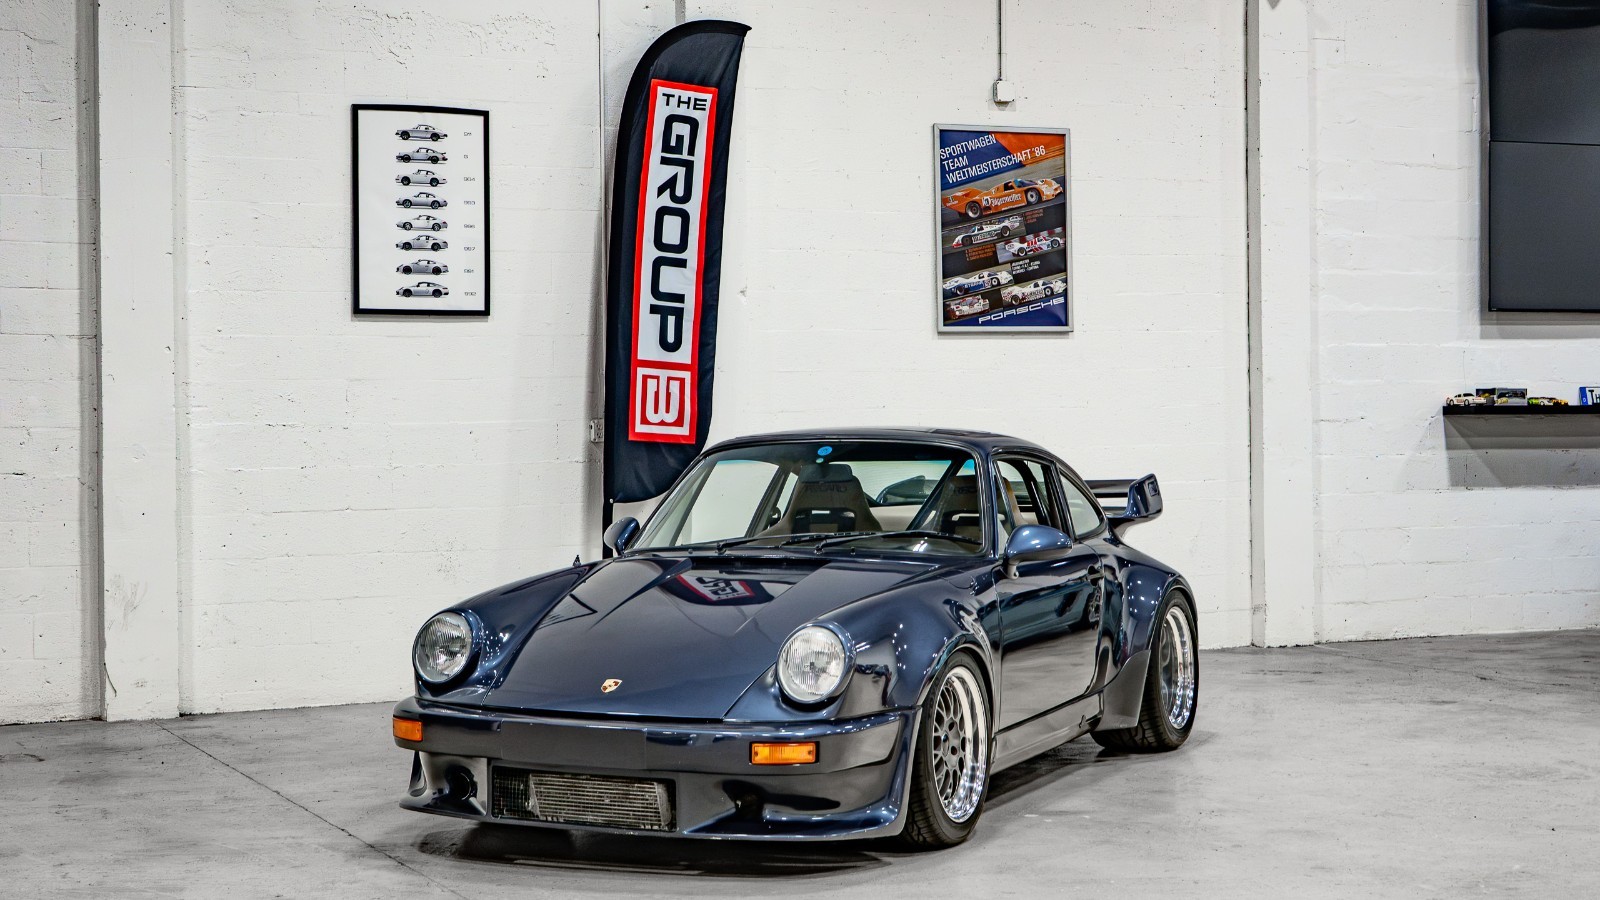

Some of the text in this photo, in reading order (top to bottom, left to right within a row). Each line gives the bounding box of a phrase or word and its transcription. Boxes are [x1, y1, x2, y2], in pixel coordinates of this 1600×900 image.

[661, 92, 708, 112] THE
[940, 134, 996, 159] SPORTWAGEN
[942, 155, 969, 171] TEAM
[945, 148, 1031, 183] WELTMEISTERSCHAFT
[645, 113, 699, 425] GROUP 3
[978, 296, 1065, 324] PORSCHE
